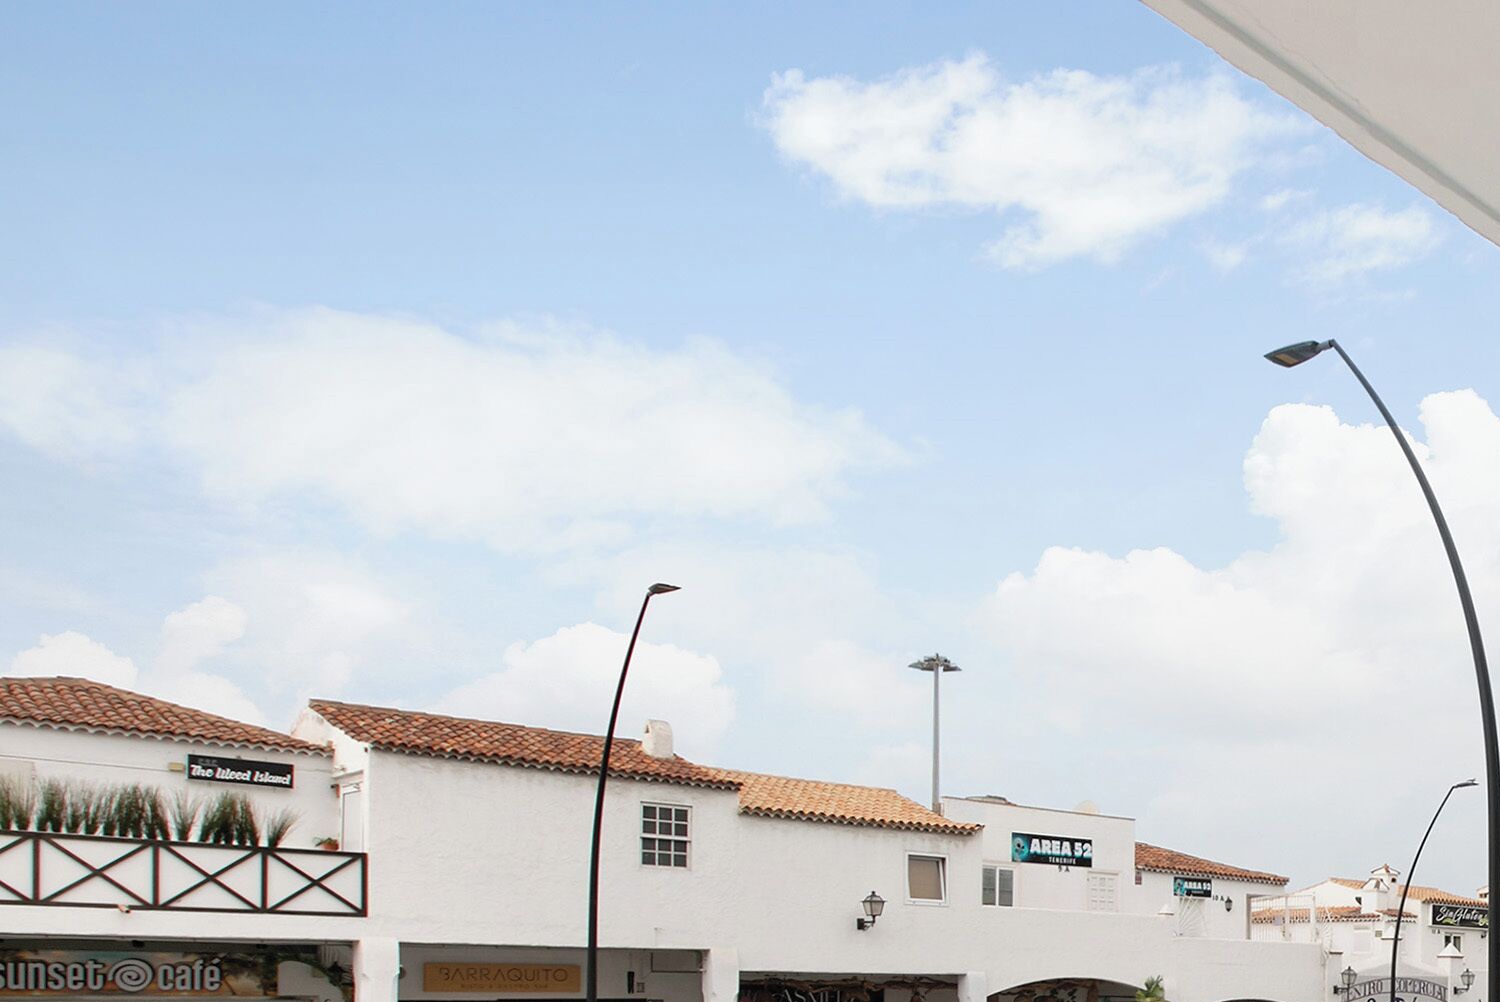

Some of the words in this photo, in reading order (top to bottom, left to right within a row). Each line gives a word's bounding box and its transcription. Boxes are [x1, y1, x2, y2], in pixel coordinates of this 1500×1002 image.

[191, 764, 213, 778] The
[215, 767, 251, 780] Weed
[253, 771, 292, 785] Island
[1030, 838, 1072, 856] AREA
[1073, 841, 1092, 857] 52
[1048, 856, 1076, 865] TENERIFE
[1184, 881, 1202, 889] AREA
[1203, 882, 1211, 890] 52
[157, 958, 223, 991] café
[438, 967, 569, 983] BARRAQUITO
